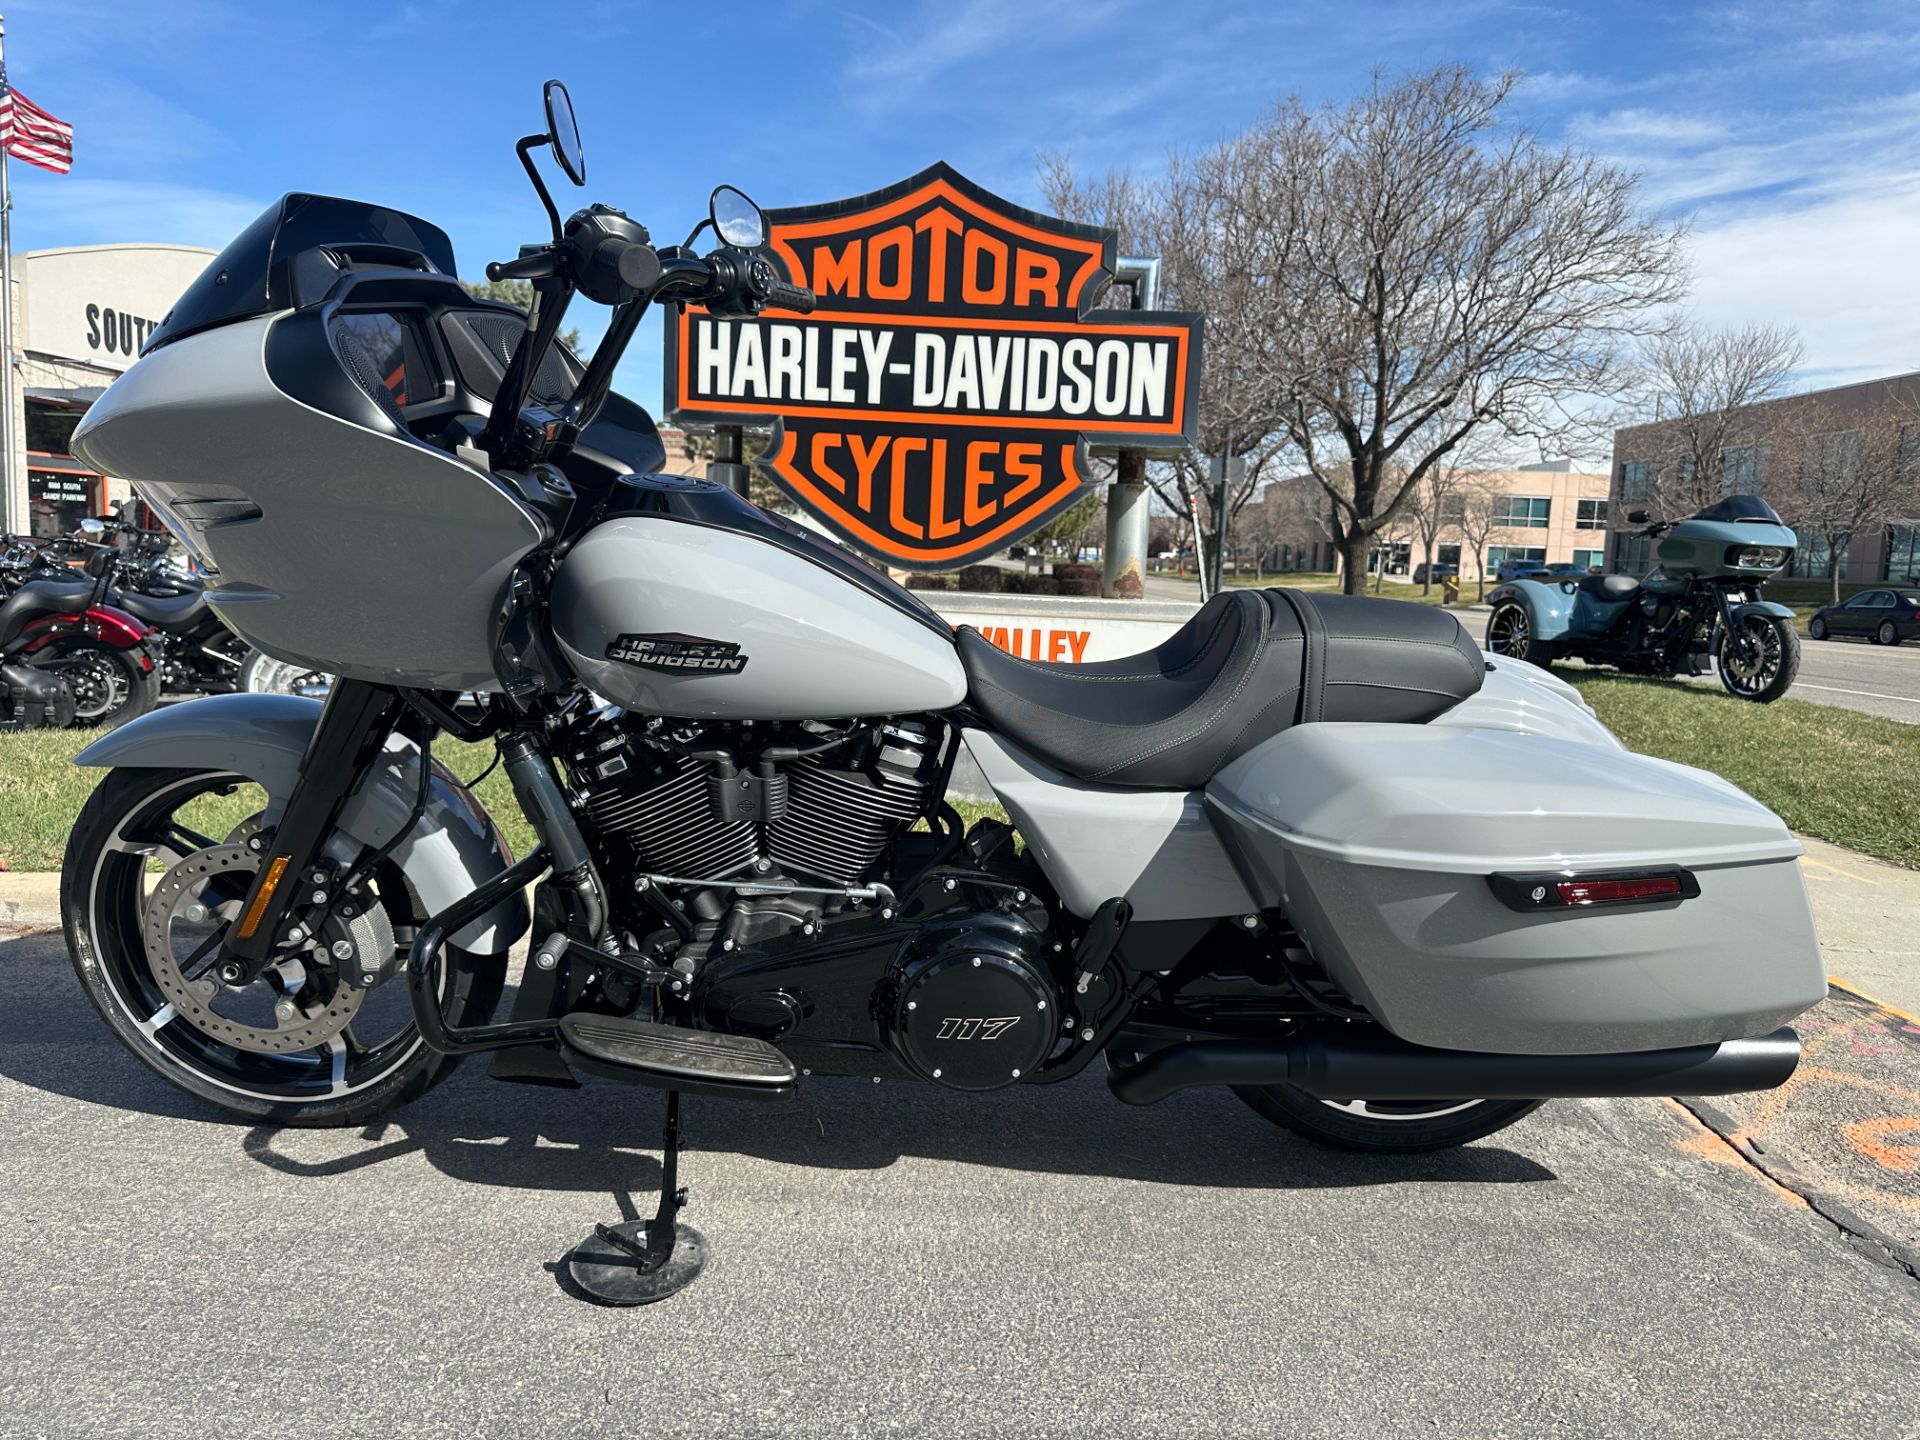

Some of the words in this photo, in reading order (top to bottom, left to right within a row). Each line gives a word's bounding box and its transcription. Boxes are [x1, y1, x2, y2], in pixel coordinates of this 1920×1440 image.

[813, 206, 1061, 308] MOTOR
[86, 303, 159, 359] SOUT
[698, 320, 1168, 417] HARLEY-DAVIDSON
[811, 432, 1043, 540] CYCLES
[610, 649, 741, 669] DAVIDSON
[936, 1016, 1021, 1040] 117
